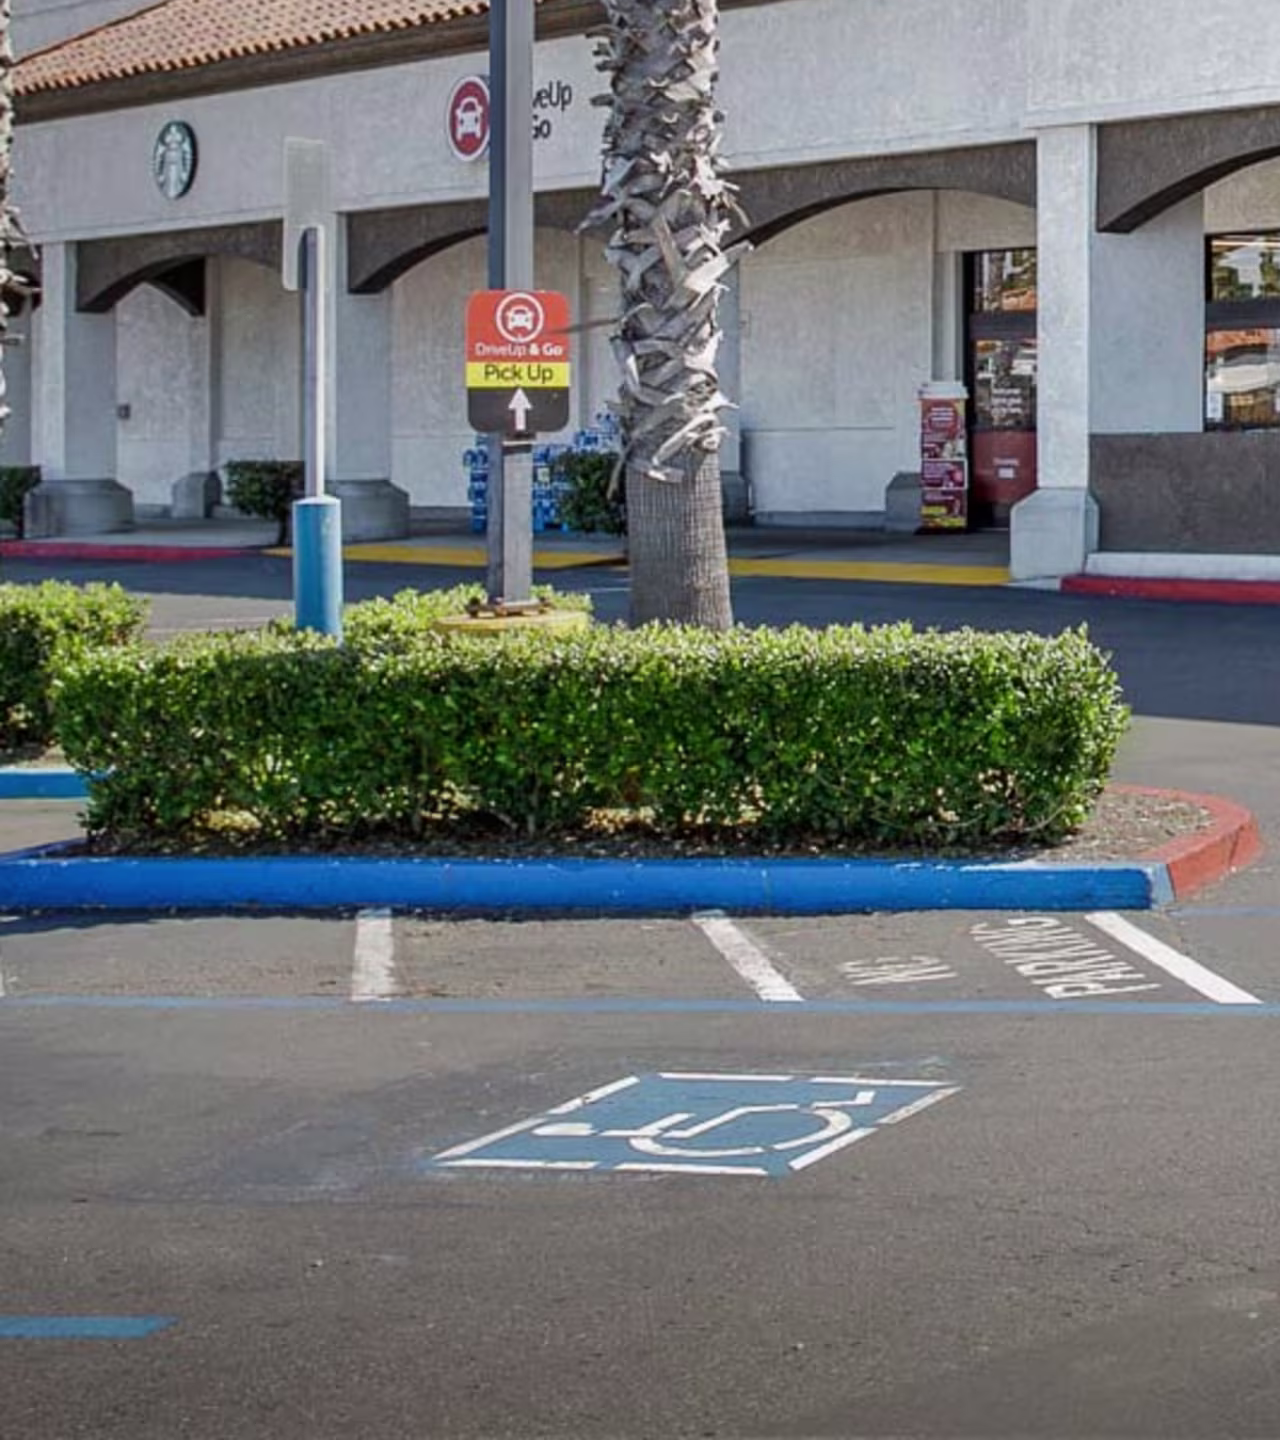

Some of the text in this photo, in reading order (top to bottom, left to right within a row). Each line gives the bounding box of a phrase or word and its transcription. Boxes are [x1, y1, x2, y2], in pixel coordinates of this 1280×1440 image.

[475, 342, 564, 358] DriveUp & Go
[484, 363, 554, 385] Pick Up
[968, 916, 1161, 999] PARKING
